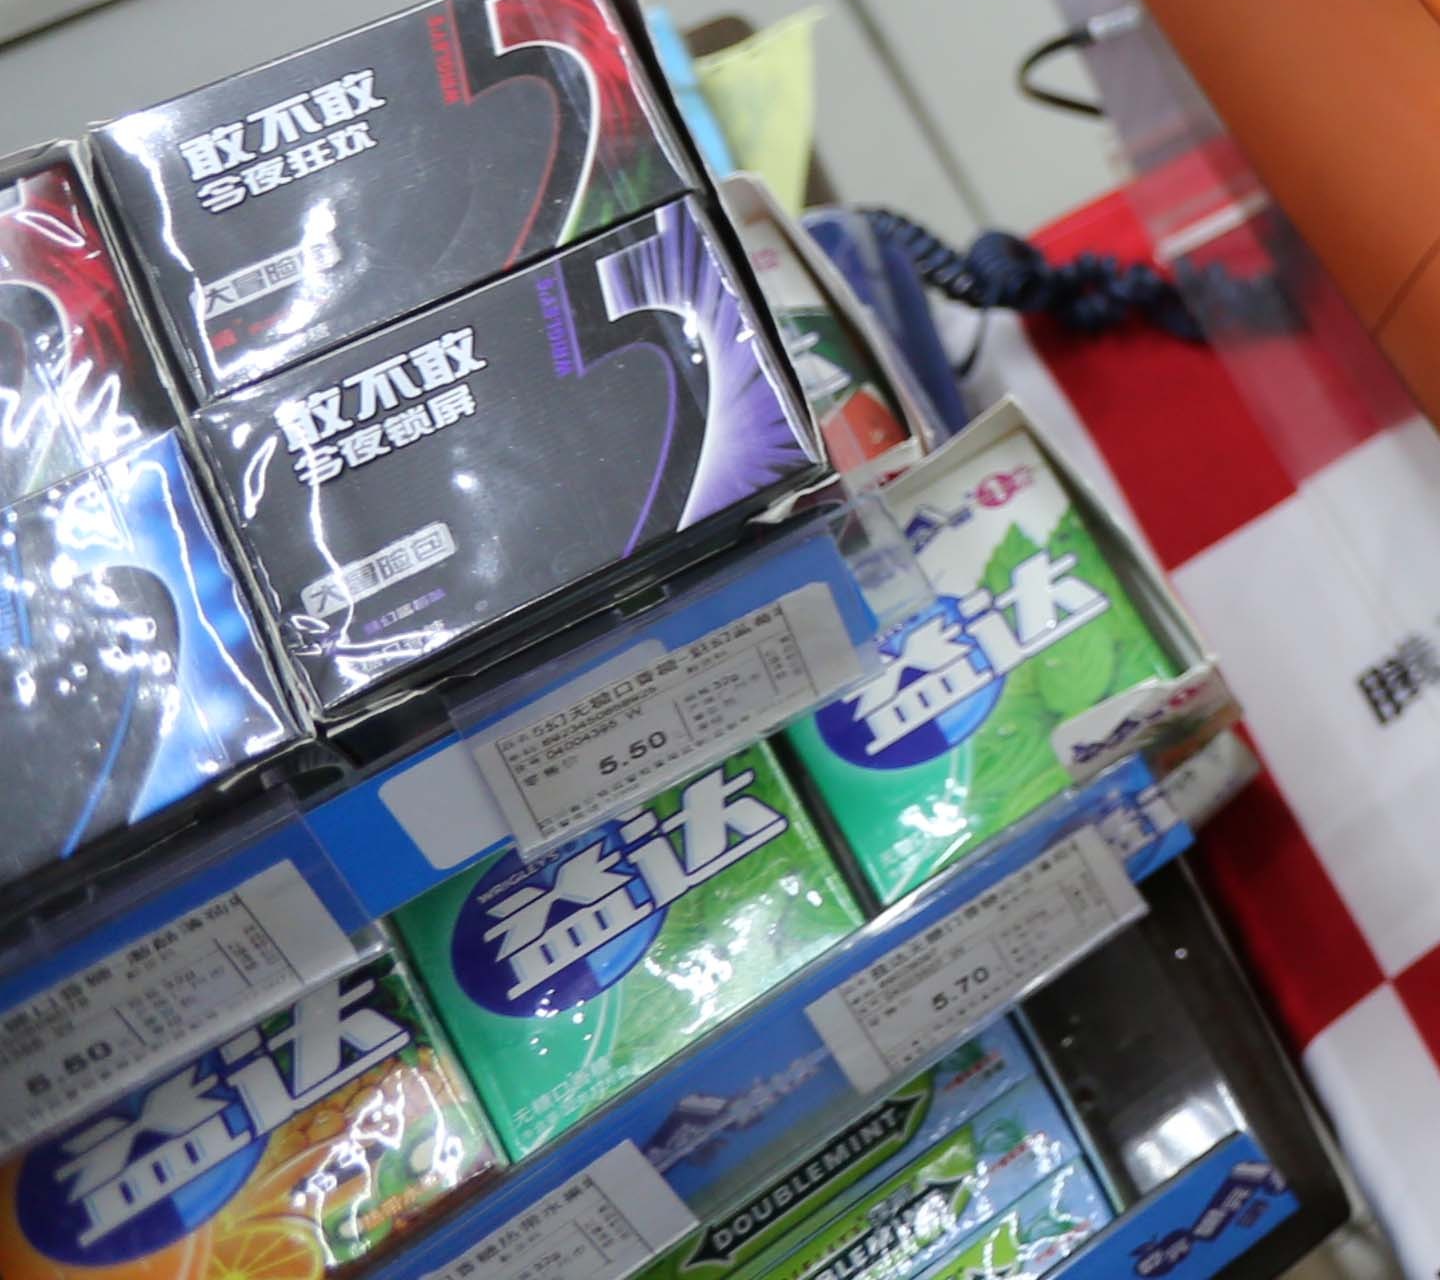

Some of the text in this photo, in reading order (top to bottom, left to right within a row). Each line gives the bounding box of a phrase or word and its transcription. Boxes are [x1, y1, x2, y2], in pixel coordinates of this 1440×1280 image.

[178, 67, 387, 182] 敢不敢
[197, 120, 379, 214] 今夜狂欢
[273, 326, 489, 454] 敢不敢
[293, 383, 477, 487] 今夜锁屏
[308, 530, 447, 614] 大冒险包
[838, 549, 1112, 756] 益达
[599, 730, 667, 776] 5.50
[484, 767, 789, 1002] 益达
[930, 963, 991, 1016] 5.70
[54, 977, 411, 1249] 益达
[710, 1105, 899, 1253] DOUBLEMINT
